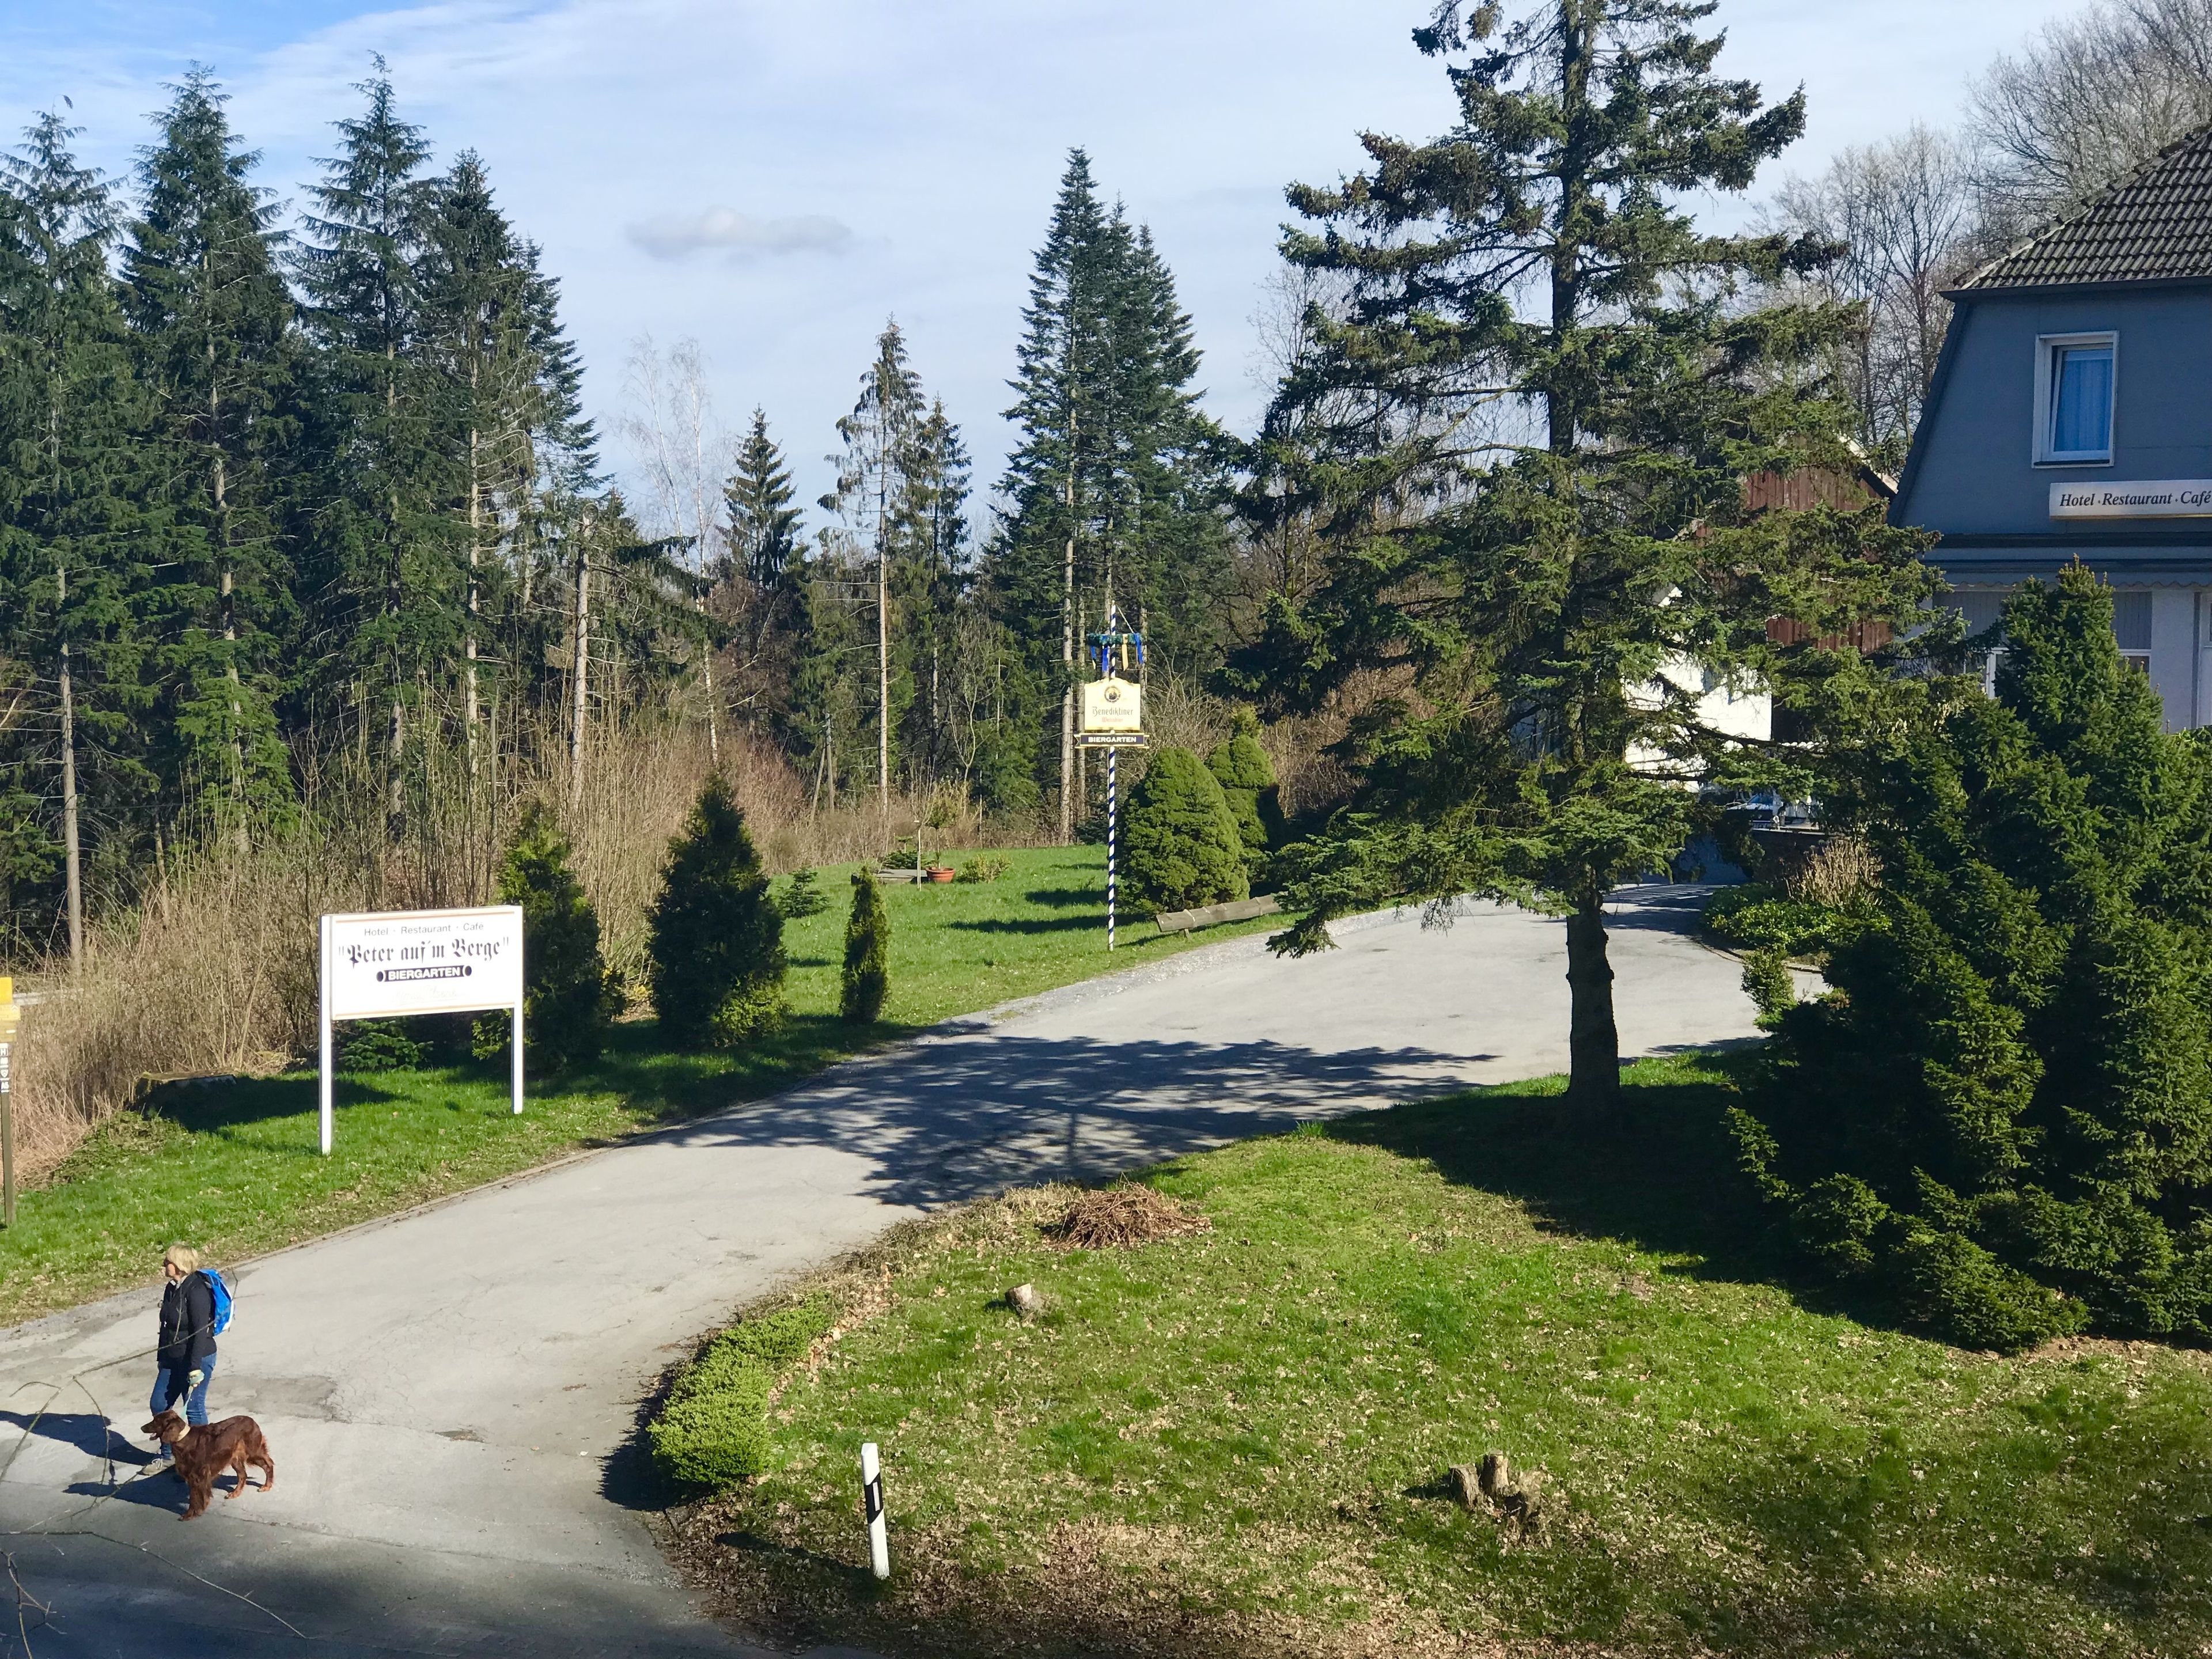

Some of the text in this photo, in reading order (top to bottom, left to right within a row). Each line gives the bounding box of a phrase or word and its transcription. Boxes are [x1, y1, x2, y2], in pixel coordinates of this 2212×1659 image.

[2059, 491, 2211, 507] Hotel Restaurant Café
[1092, 706, 1134, 717] Benediktiner
[363, 927, 389, 937] Hotel
[401, 924, 452, 935] Restaurant
[388, 966, 461, 981] BIERGARTEN
